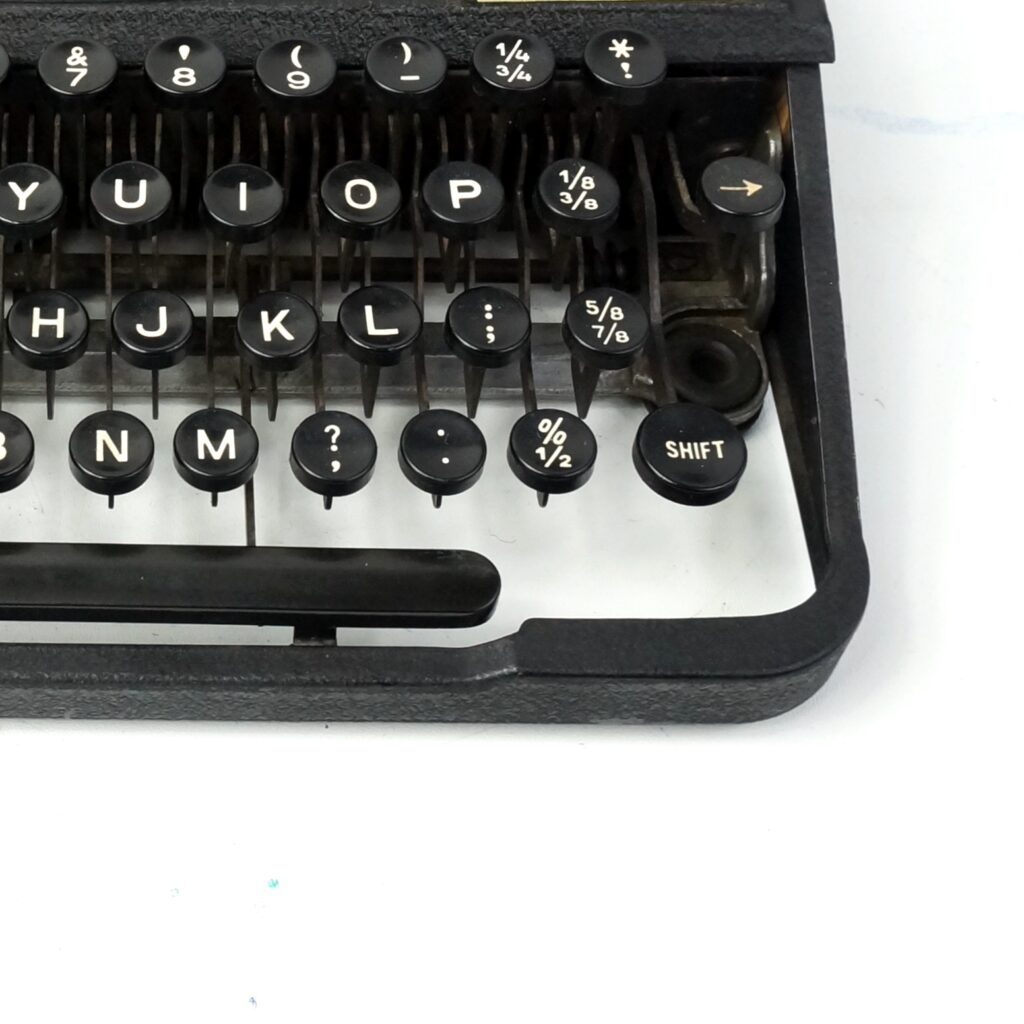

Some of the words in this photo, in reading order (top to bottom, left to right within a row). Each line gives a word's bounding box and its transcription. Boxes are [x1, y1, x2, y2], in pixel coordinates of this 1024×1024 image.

[66, 46, 89, 67] &
[65, 67, 89, 87] 7
[171, 66, 197, 87] 8
[286, 70, 311, 90] 9
[7, 181, 40, 211] Y
[114, 178, 148, 209] U
[239, 181, 247, 212] I
[344, 178, 378, 210] O
[448, 179, 482, 209] P
[31, 306, 65, 339] H
[135, 305, 168, 338] J
[260, 308, 295, 342] K
[364, 304, 399, 336] L
[95, 429, 129, 463] N
[196, 428, 237, 461] M
[323, 424, 341, 452] ?
[537, 417, 568, 446] %
[665, 440, 725, 460] SHIFT
